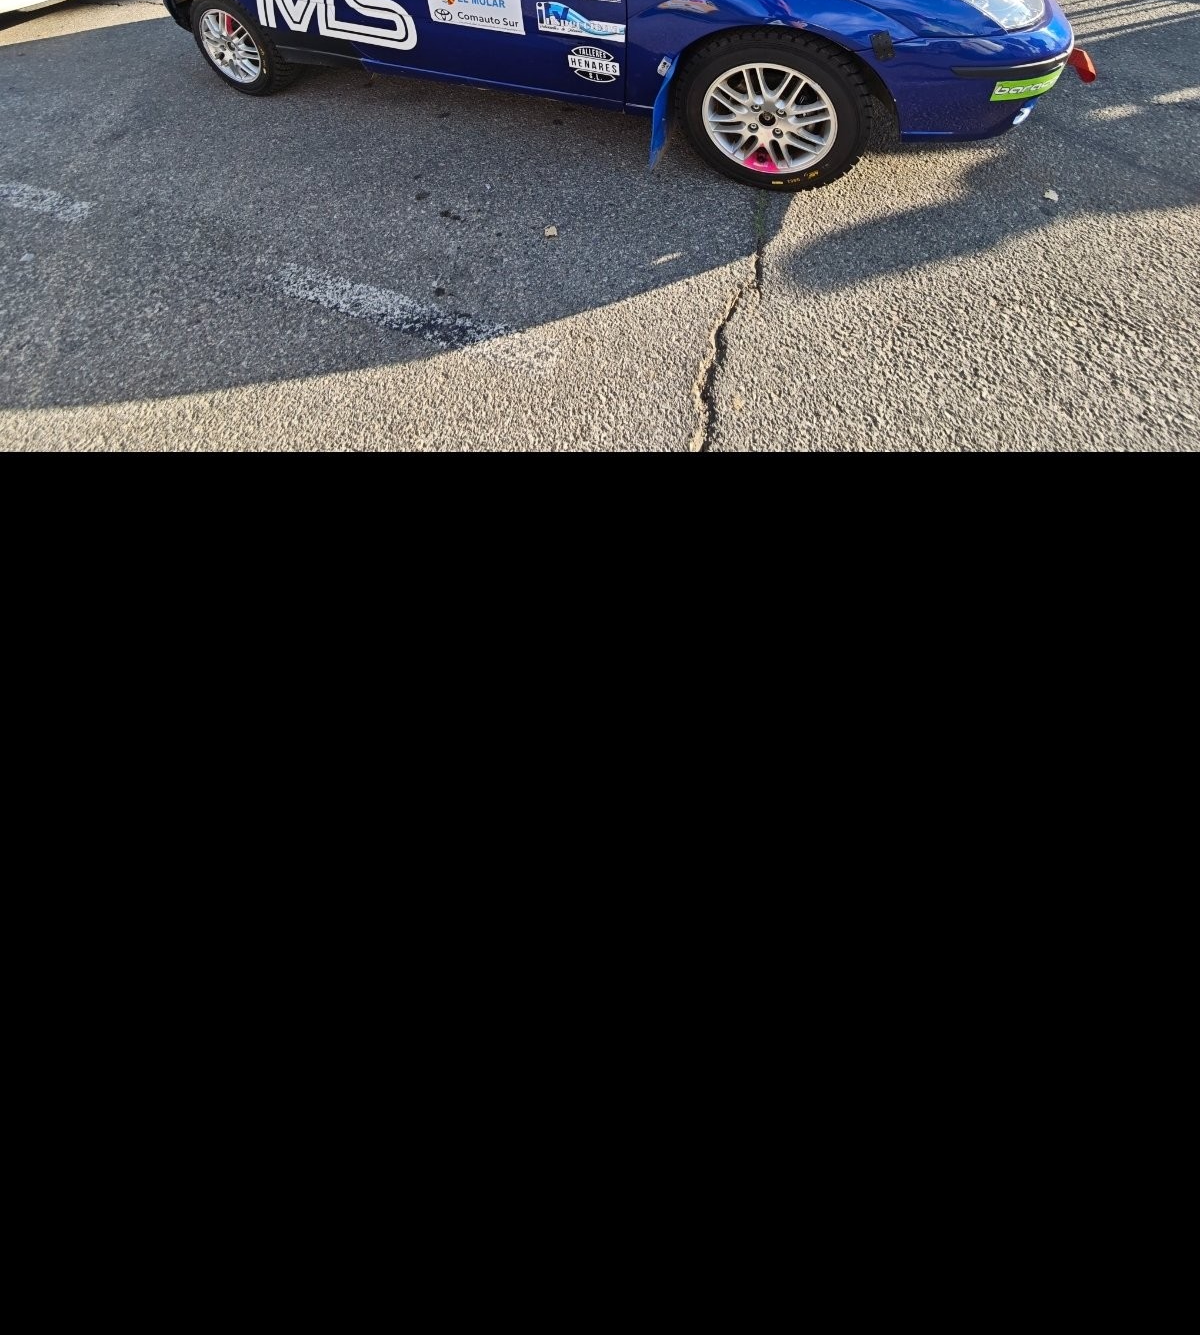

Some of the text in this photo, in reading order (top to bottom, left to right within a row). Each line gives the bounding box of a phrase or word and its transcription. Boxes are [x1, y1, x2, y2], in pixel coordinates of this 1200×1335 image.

[457, 11, 501, 25] Comauto
[502, 17, 519, 28] Sur
[578, 47, 607, 59] TALLERES
[570, 57, 617, 74] HENARES
